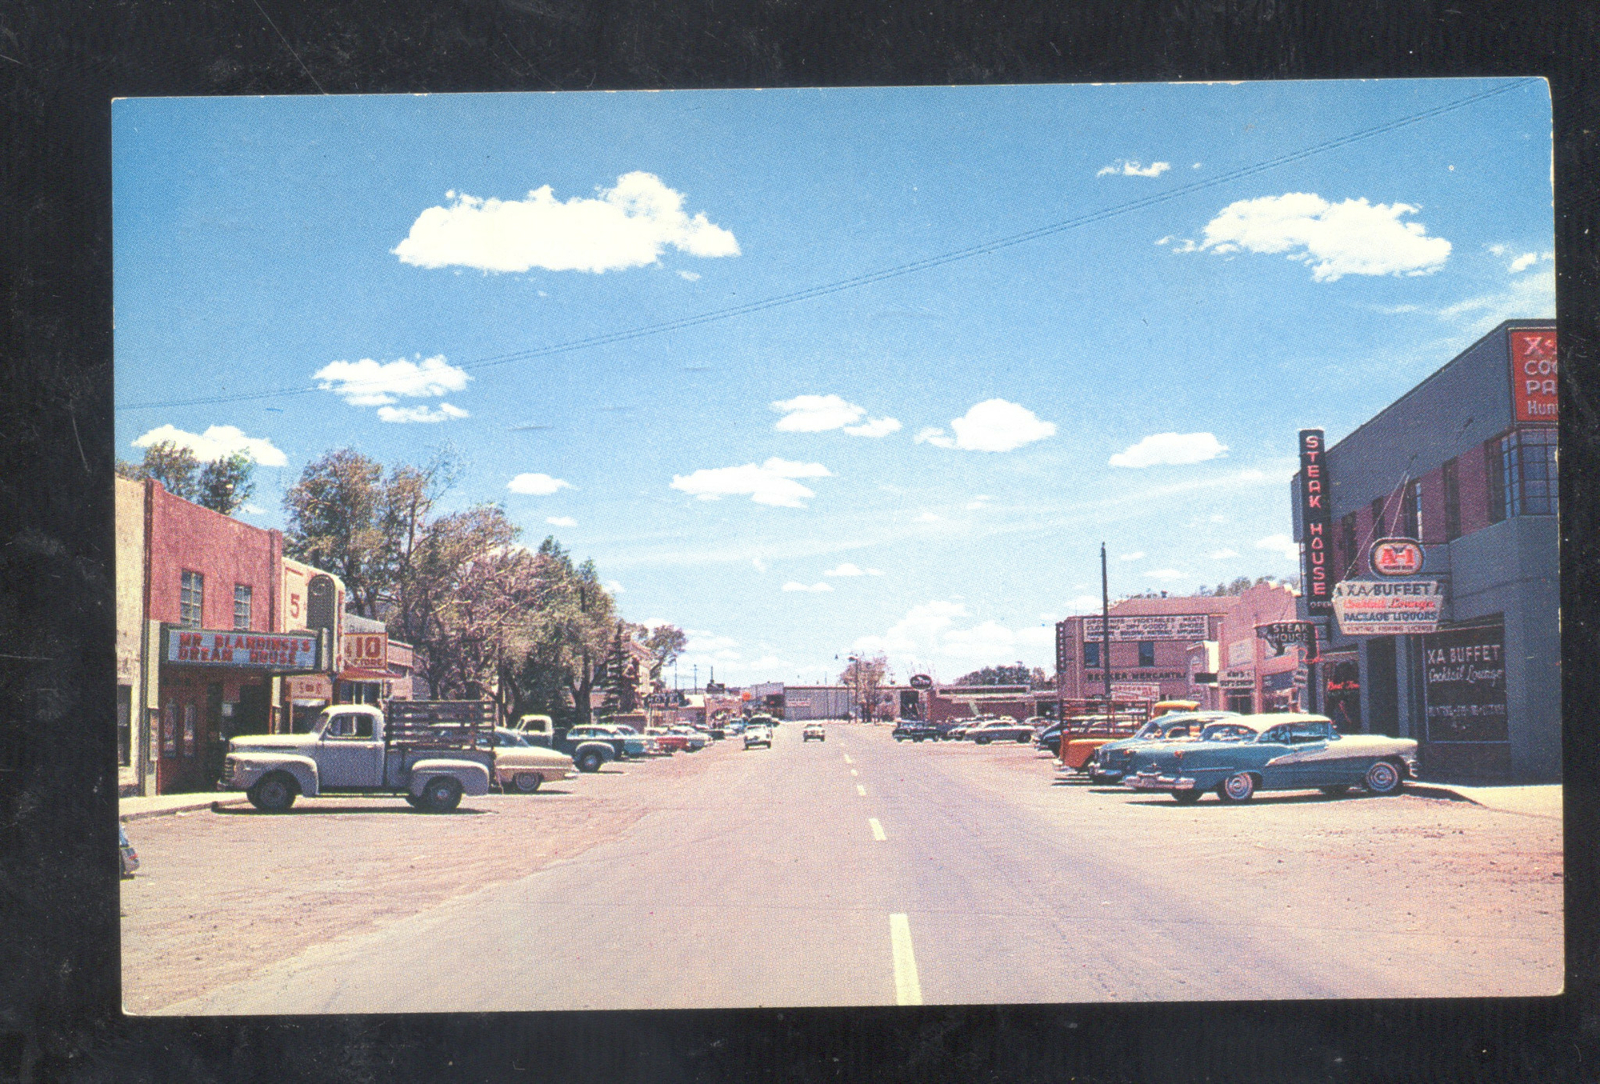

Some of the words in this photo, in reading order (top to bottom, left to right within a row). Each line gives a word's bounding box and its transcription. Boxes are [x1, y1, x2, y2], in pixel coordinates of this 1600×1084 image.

[1305, 435, 1322, 508] STEAK
[1310, 523, 1327, 596] HOUSE
[290, 593, 300, 619] 5
[1388, 598, 1436, 611] Lounge
[1343, 612, 1389, 622] PACKAGE
[1393, 611, 1438, 621] LIQUORS
[1272, 624, 1309, 633] STEAK
[1272, 633, 1309, 642] HOUSE
[178, 647, 233, 662] DREAM
[250, 650, 297, 665] HOUSE
[355, 637, 381, 658] 10
[1427, 649, 1446, 664] XA
[1450, 645, 1501, 663] BUFFET
